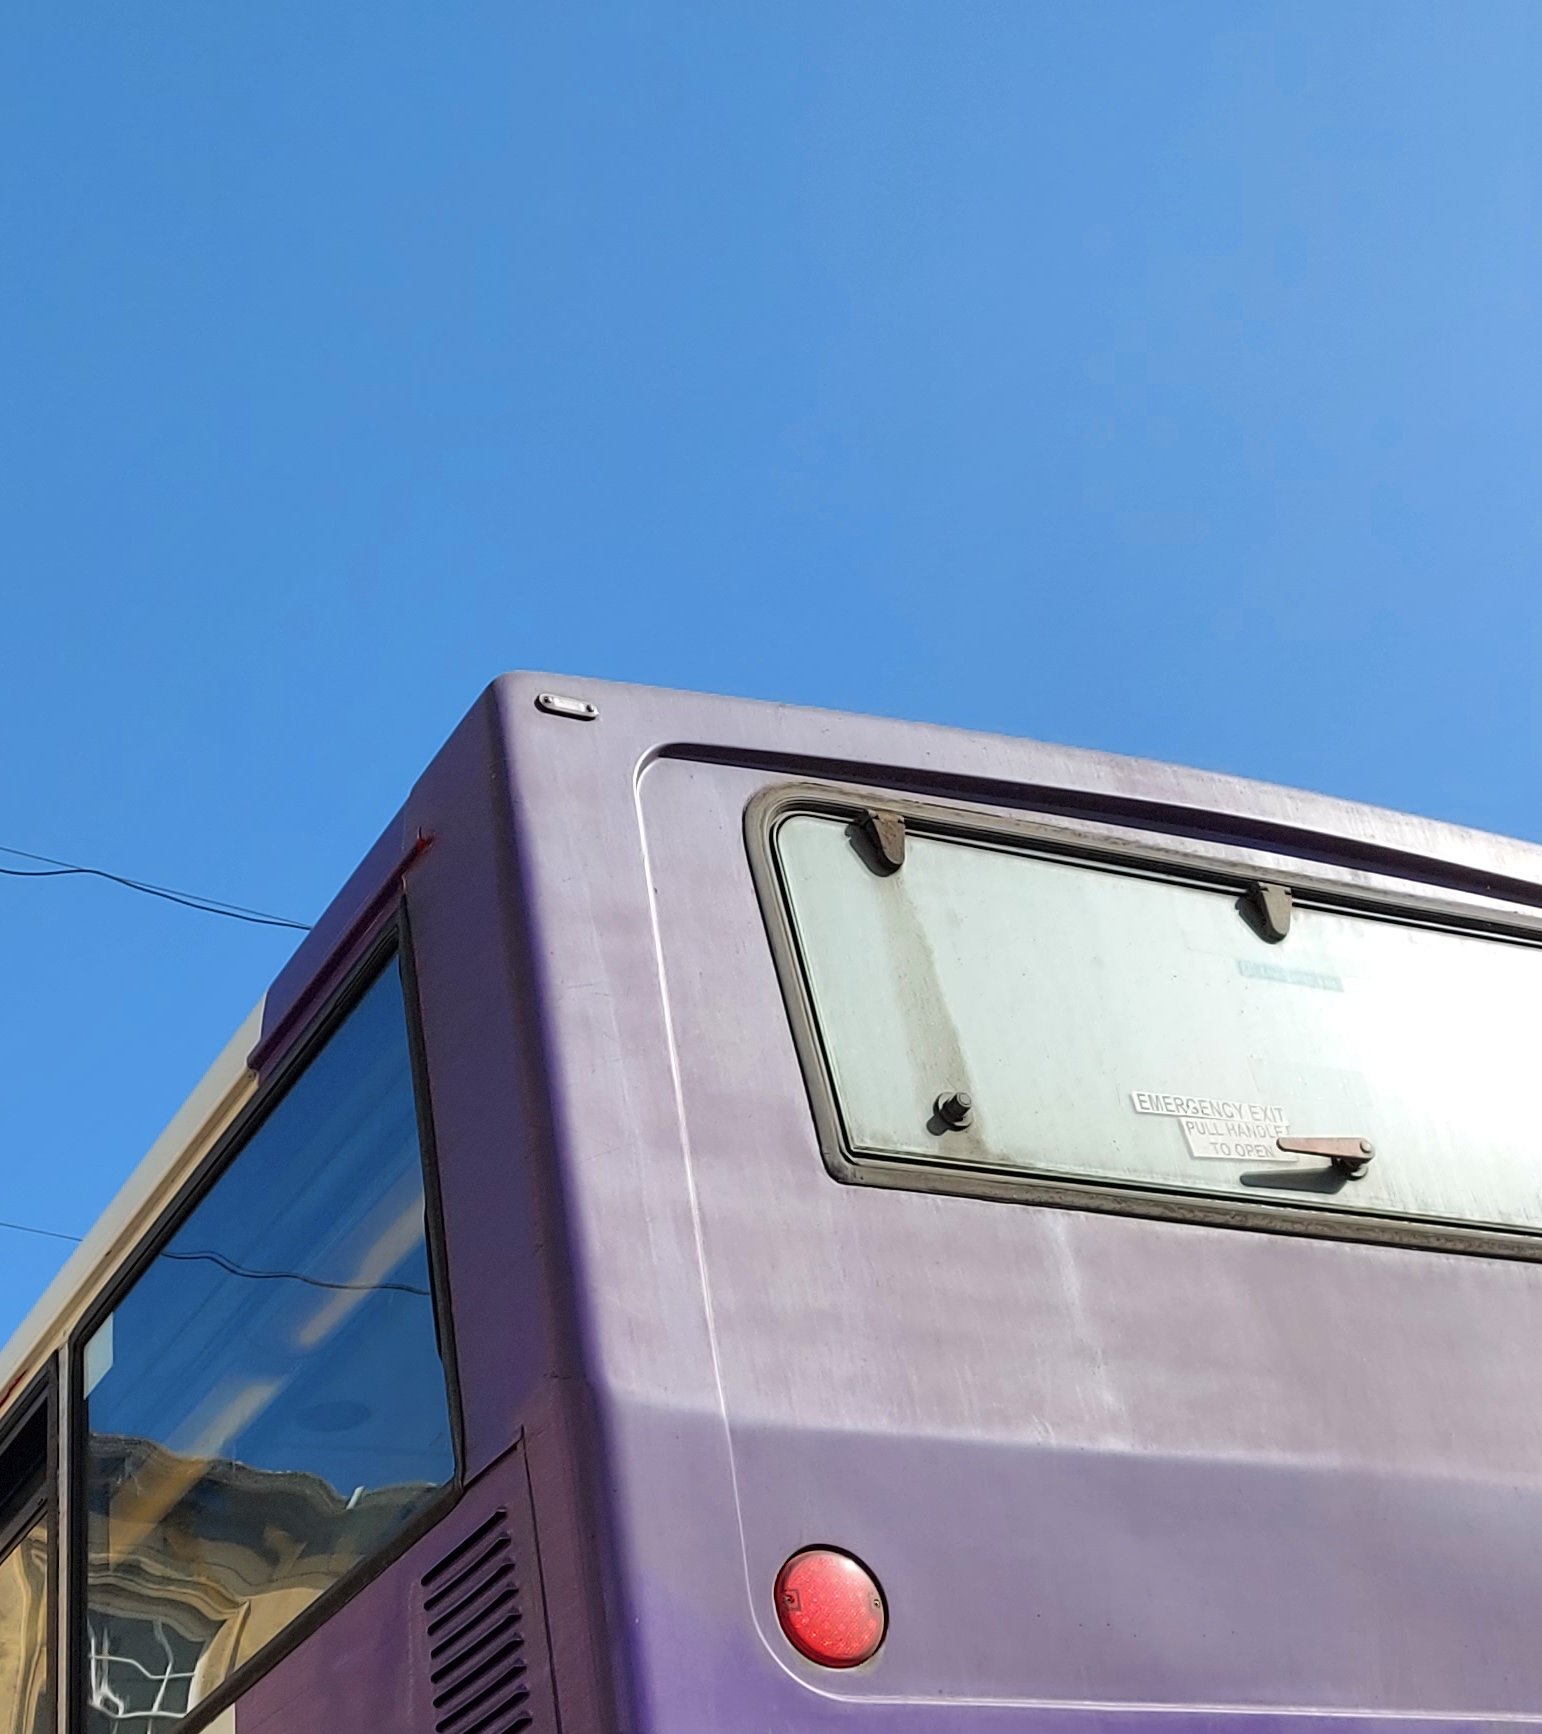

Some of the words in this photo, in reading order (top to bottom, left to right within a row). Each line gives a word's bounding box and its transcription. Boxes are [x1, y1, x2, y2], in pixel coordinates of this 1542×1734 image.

[1136, 1093, 1244, 1119] EMERGENCY
[1248, 1106, 1285, 1124] EXIT
[1186, 1121, 1224, 1137] PULL
[1210, 1142, 1231, 1156] TO
[1235, 1143, 1275, 1158] OPEN
